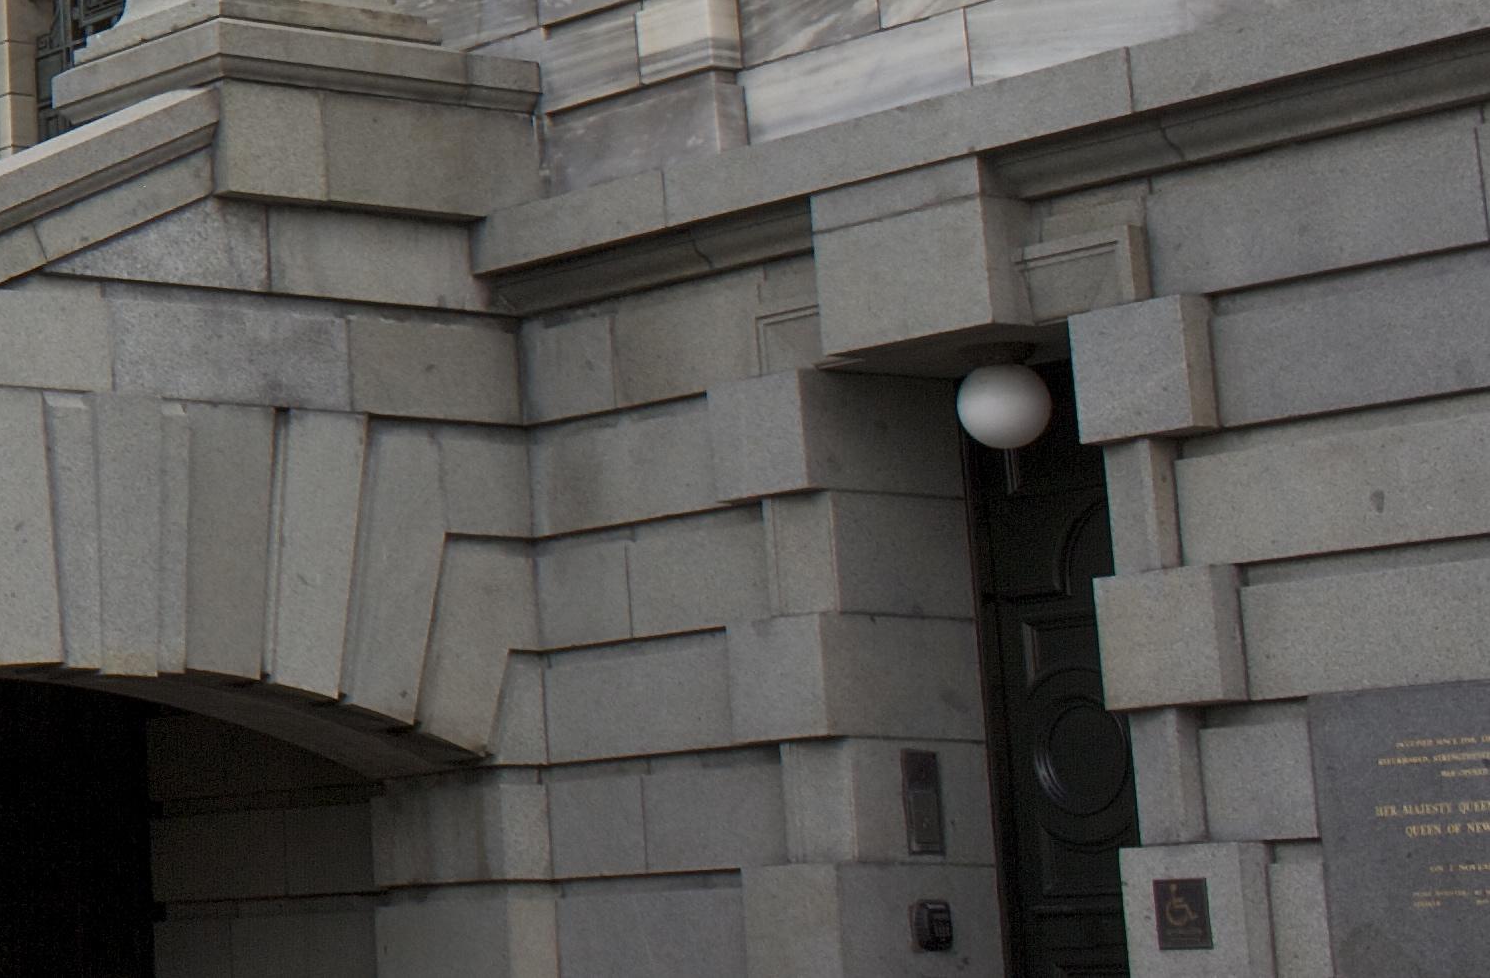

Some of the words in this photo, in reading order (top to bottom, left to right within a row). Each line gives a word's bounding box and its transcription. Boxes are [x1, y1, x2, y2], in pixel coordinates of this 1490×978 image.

[1374, 805, 1398, 818] HER
[1402, 803, 1452, 815] MAJESTY
[1405, 823, 1442, 838] QUEEN
[1447, 822, 1461, 834] OF
